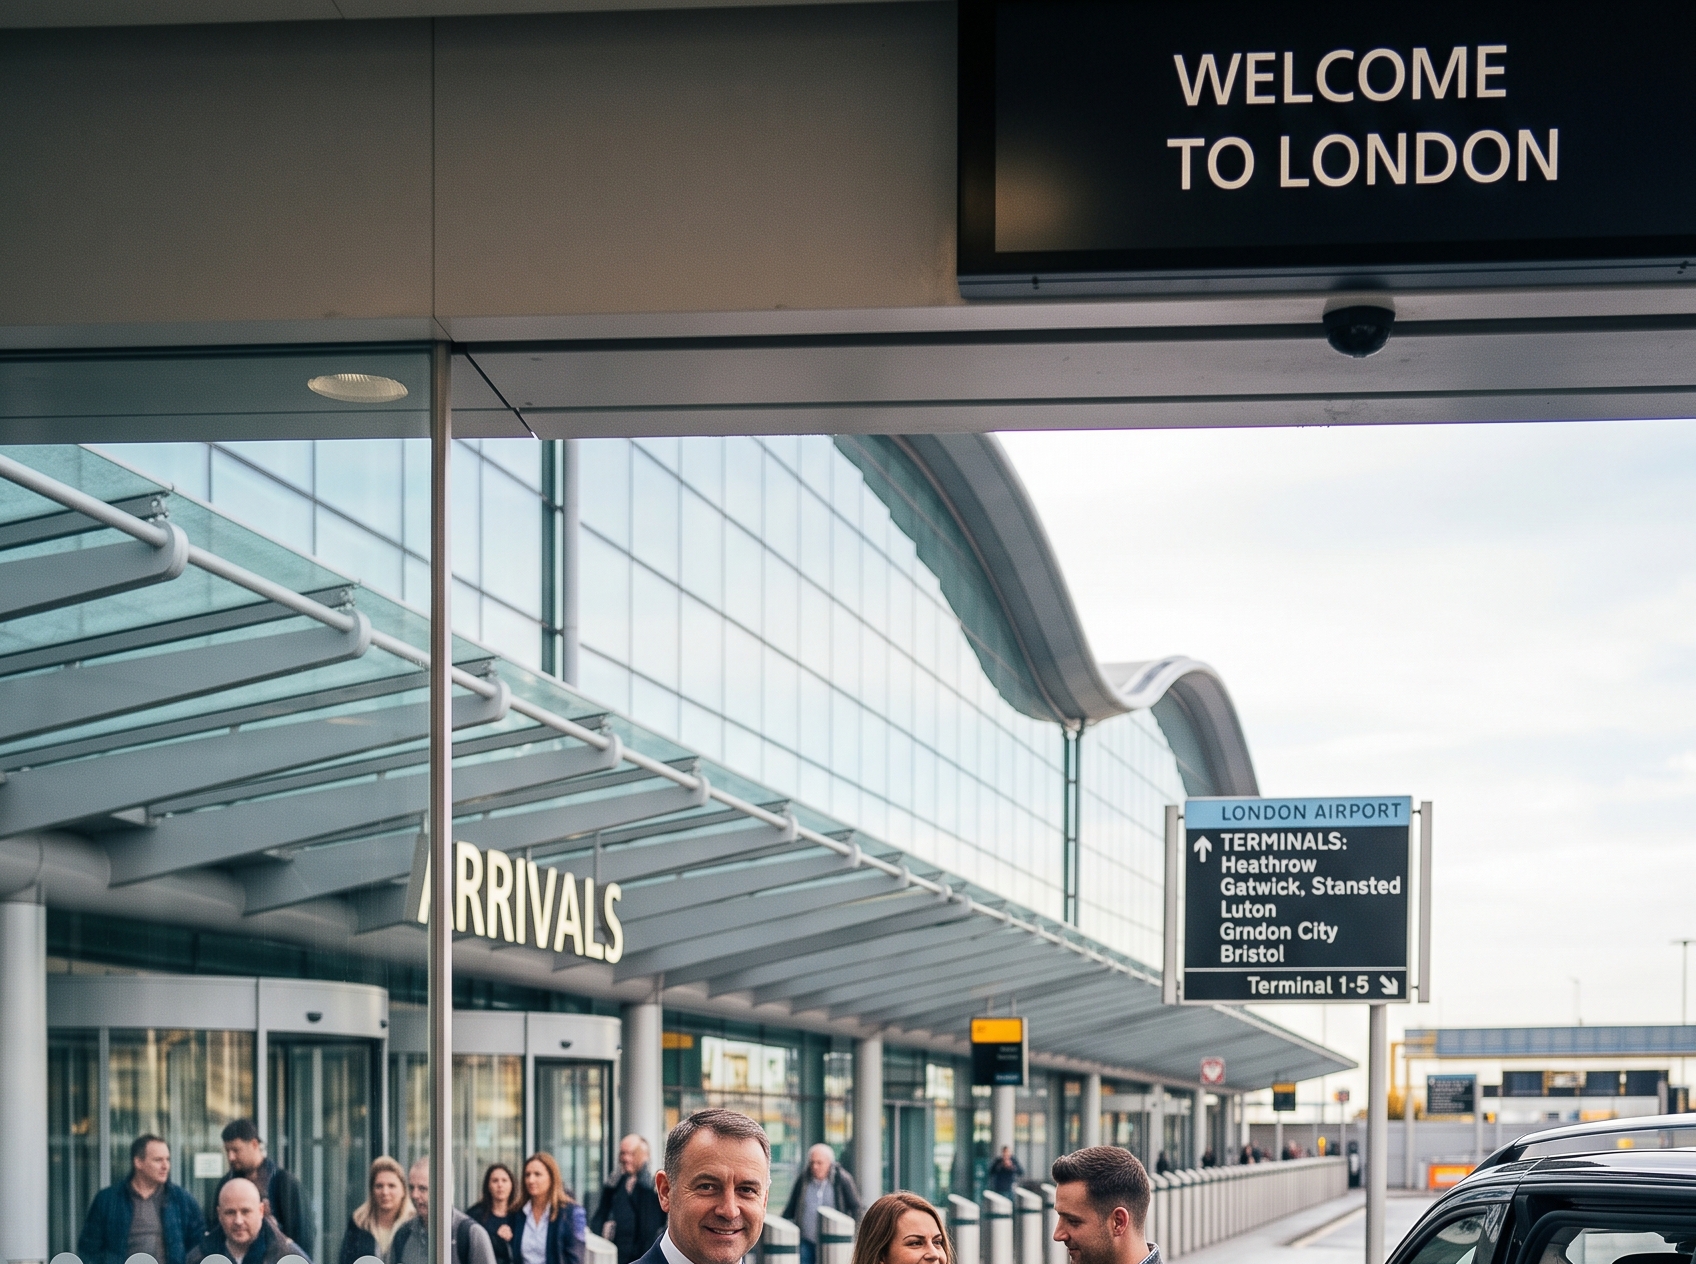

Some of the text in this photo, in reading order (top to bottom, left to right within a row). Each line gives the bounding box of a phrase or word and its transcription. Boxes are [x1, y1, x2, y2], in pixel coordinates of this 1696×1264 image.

[1174, 45, 1506, 106] WELCOME
[1167, 129, 1558, 189] TO LONDON
[1222, 803, 1401, 821] LONDON AIRPORT
[1221, 832, 1347, 851] TERMINALS:
[1222, 855, 1316, 873] Heathrow
[1221, 876, 1400, 897] Gatwick, Stansted
[1222, 900, 1276, 918] Luton
[1220, 922, 1338, 943] Grndon City
[1221, 944, 1284, 962] Bristol
[1247, 976, 1369, 994] Terminal 1-5
